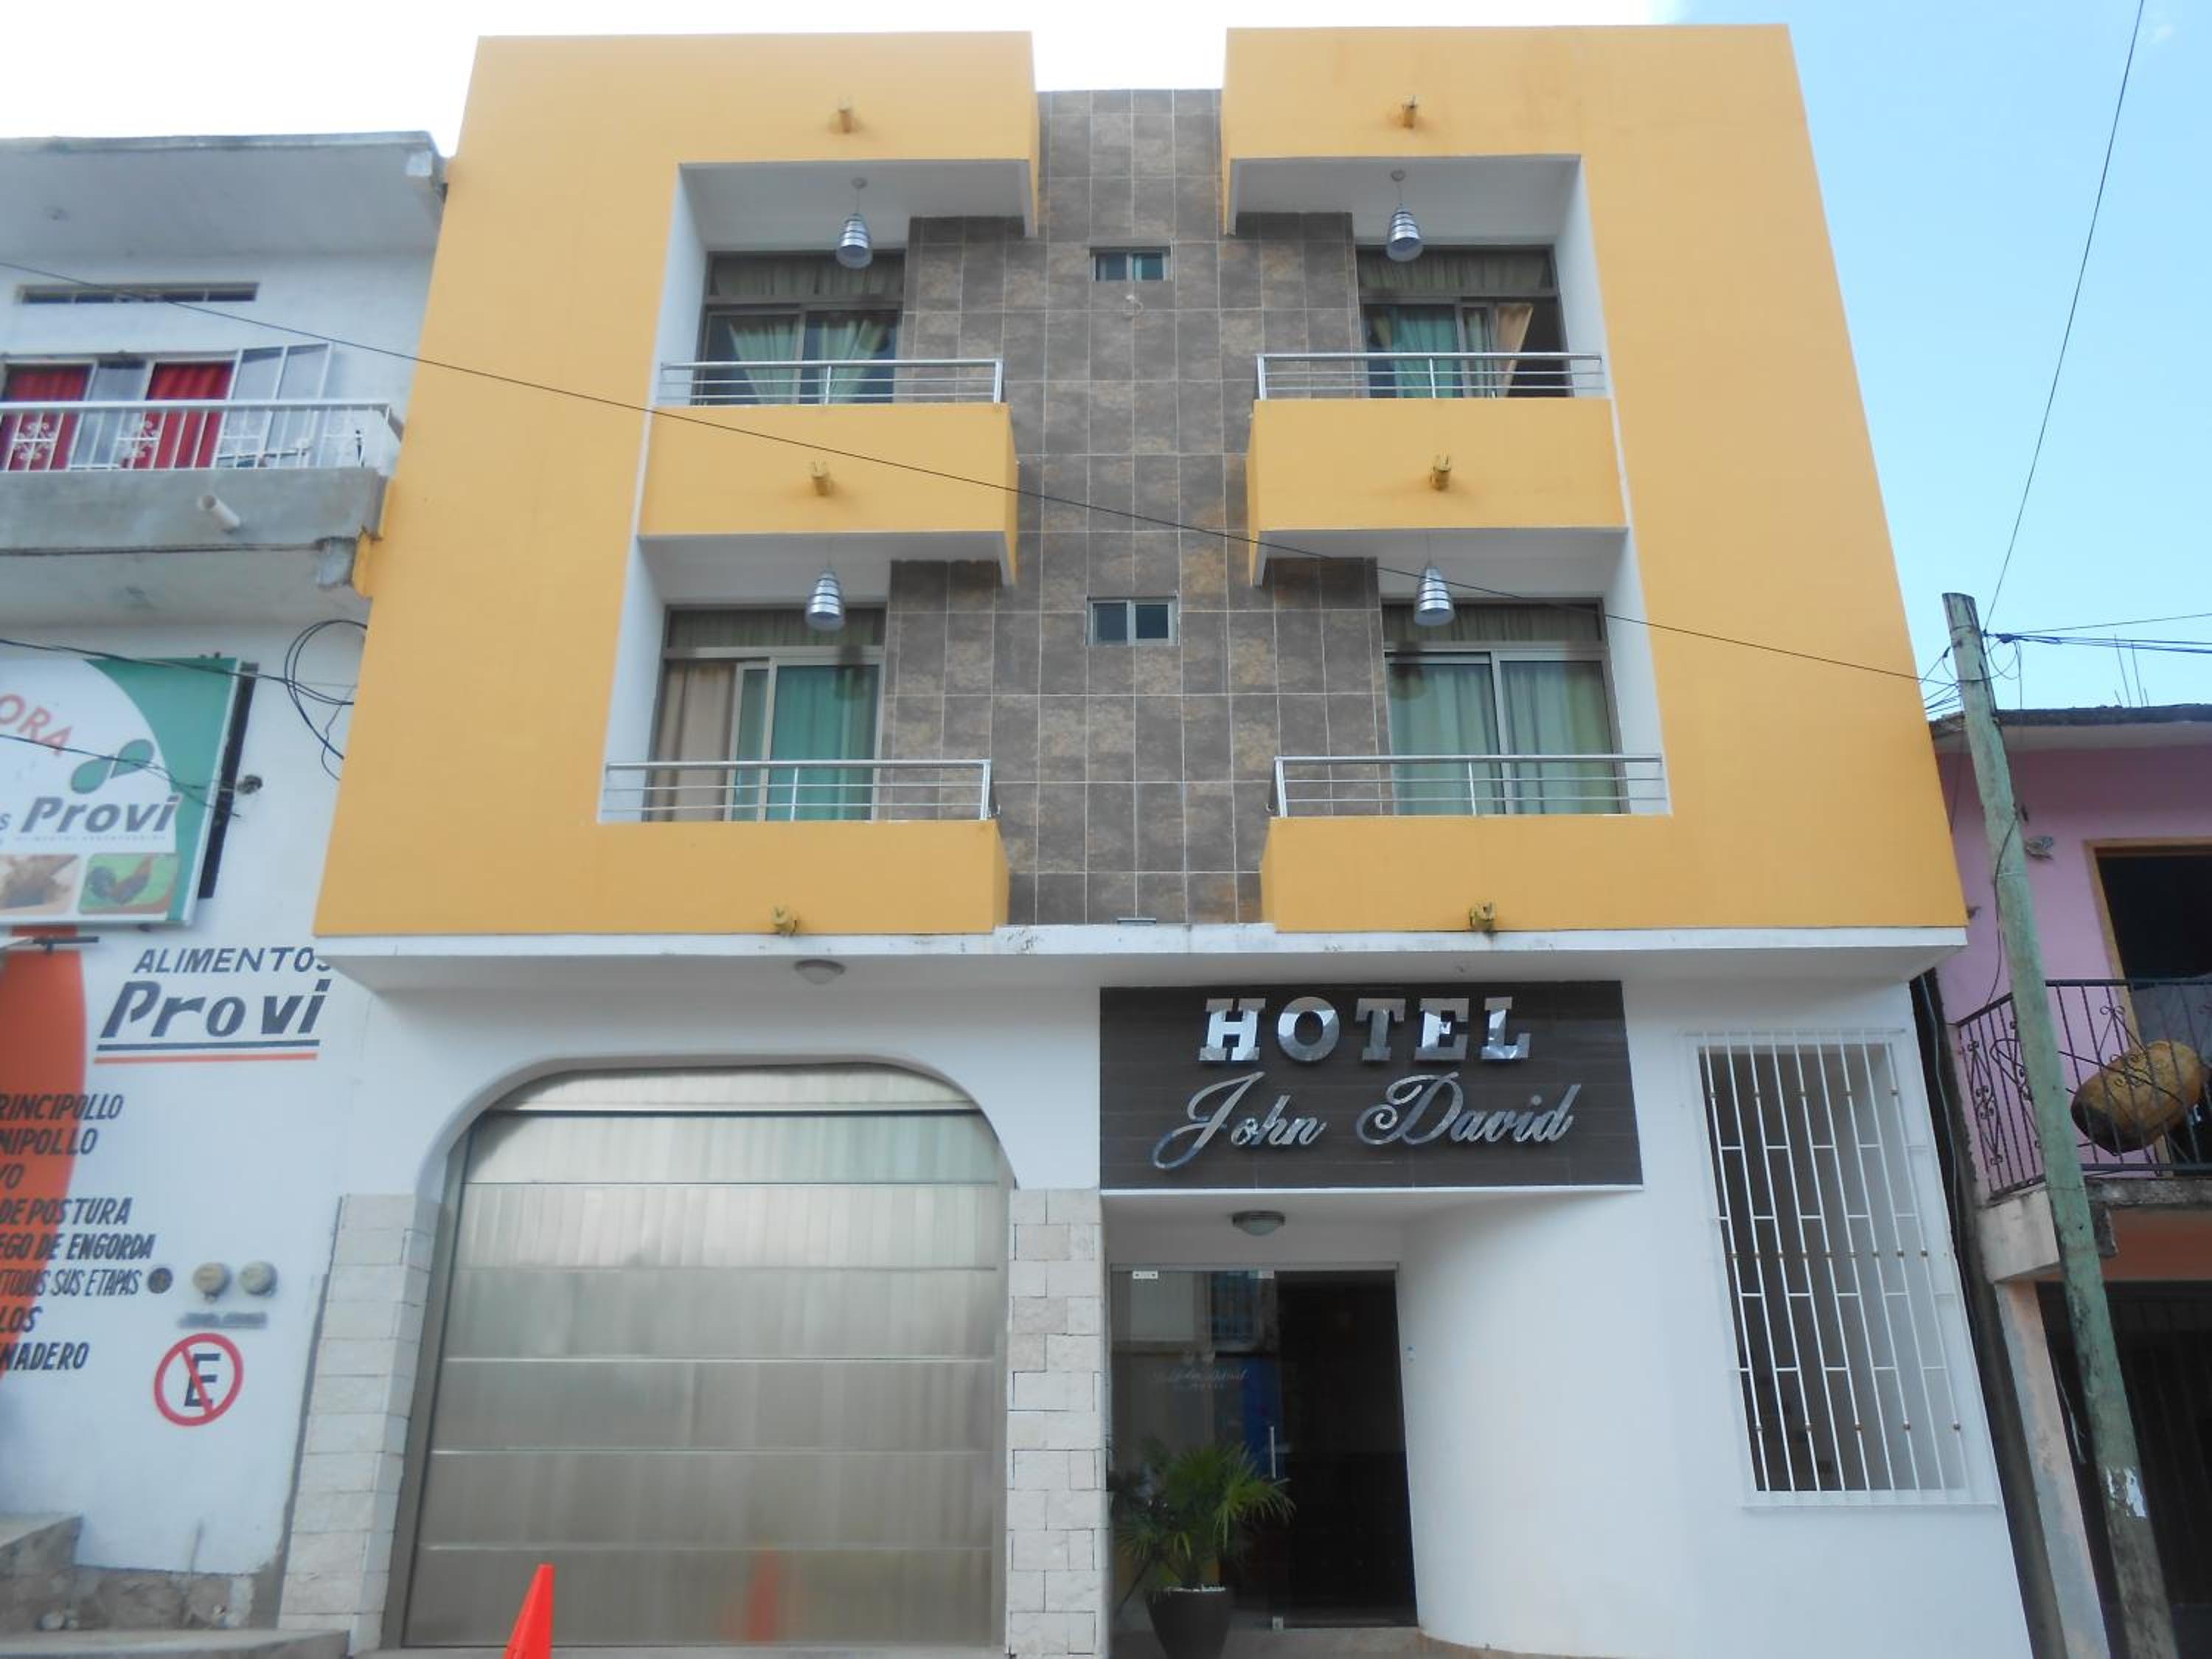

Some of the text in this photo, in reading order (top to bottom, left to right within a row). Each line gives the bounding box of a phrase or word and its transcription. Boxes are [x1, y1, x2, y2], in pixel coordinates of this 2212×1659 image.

[20, 796, 182, 834] Provi
[100, 979, 332, 1039] Provi
[1199, 995, 1531, 1062] HOTEL
[1152, 1071, 1582, 1169] John David
[27, 1197, 133, 1225] POSTURA
[35, 1233, 64, 1260] DE
[66, 1233, 156, 1260] ENGORDA
[50, 1269, 86, 1296] SUS
[84, 1269, 142, 1296] ETAPAS
[184, 1353, 221, 1407] E
